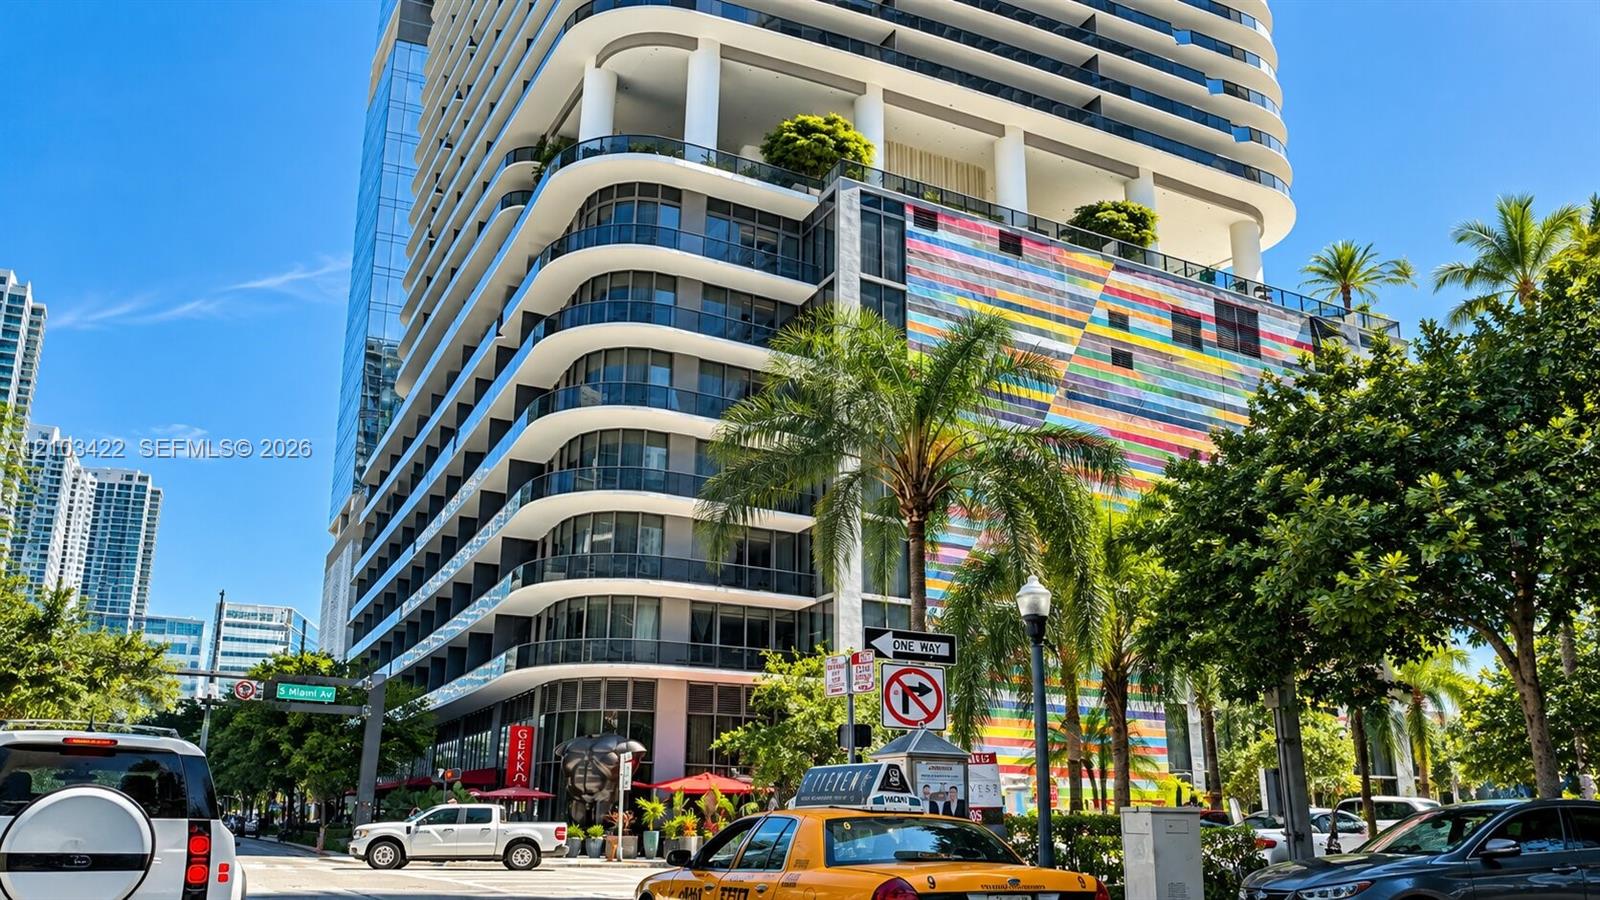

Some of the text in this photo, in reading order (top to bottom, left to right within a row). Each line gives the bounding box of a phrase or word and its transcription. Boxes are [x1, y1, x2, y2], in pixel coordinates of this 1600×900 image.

[892, 640, 941, 654] ONE WAY
[280, 687, 333, 698] S Miami Av
[927, 876, 936, 890] 9
